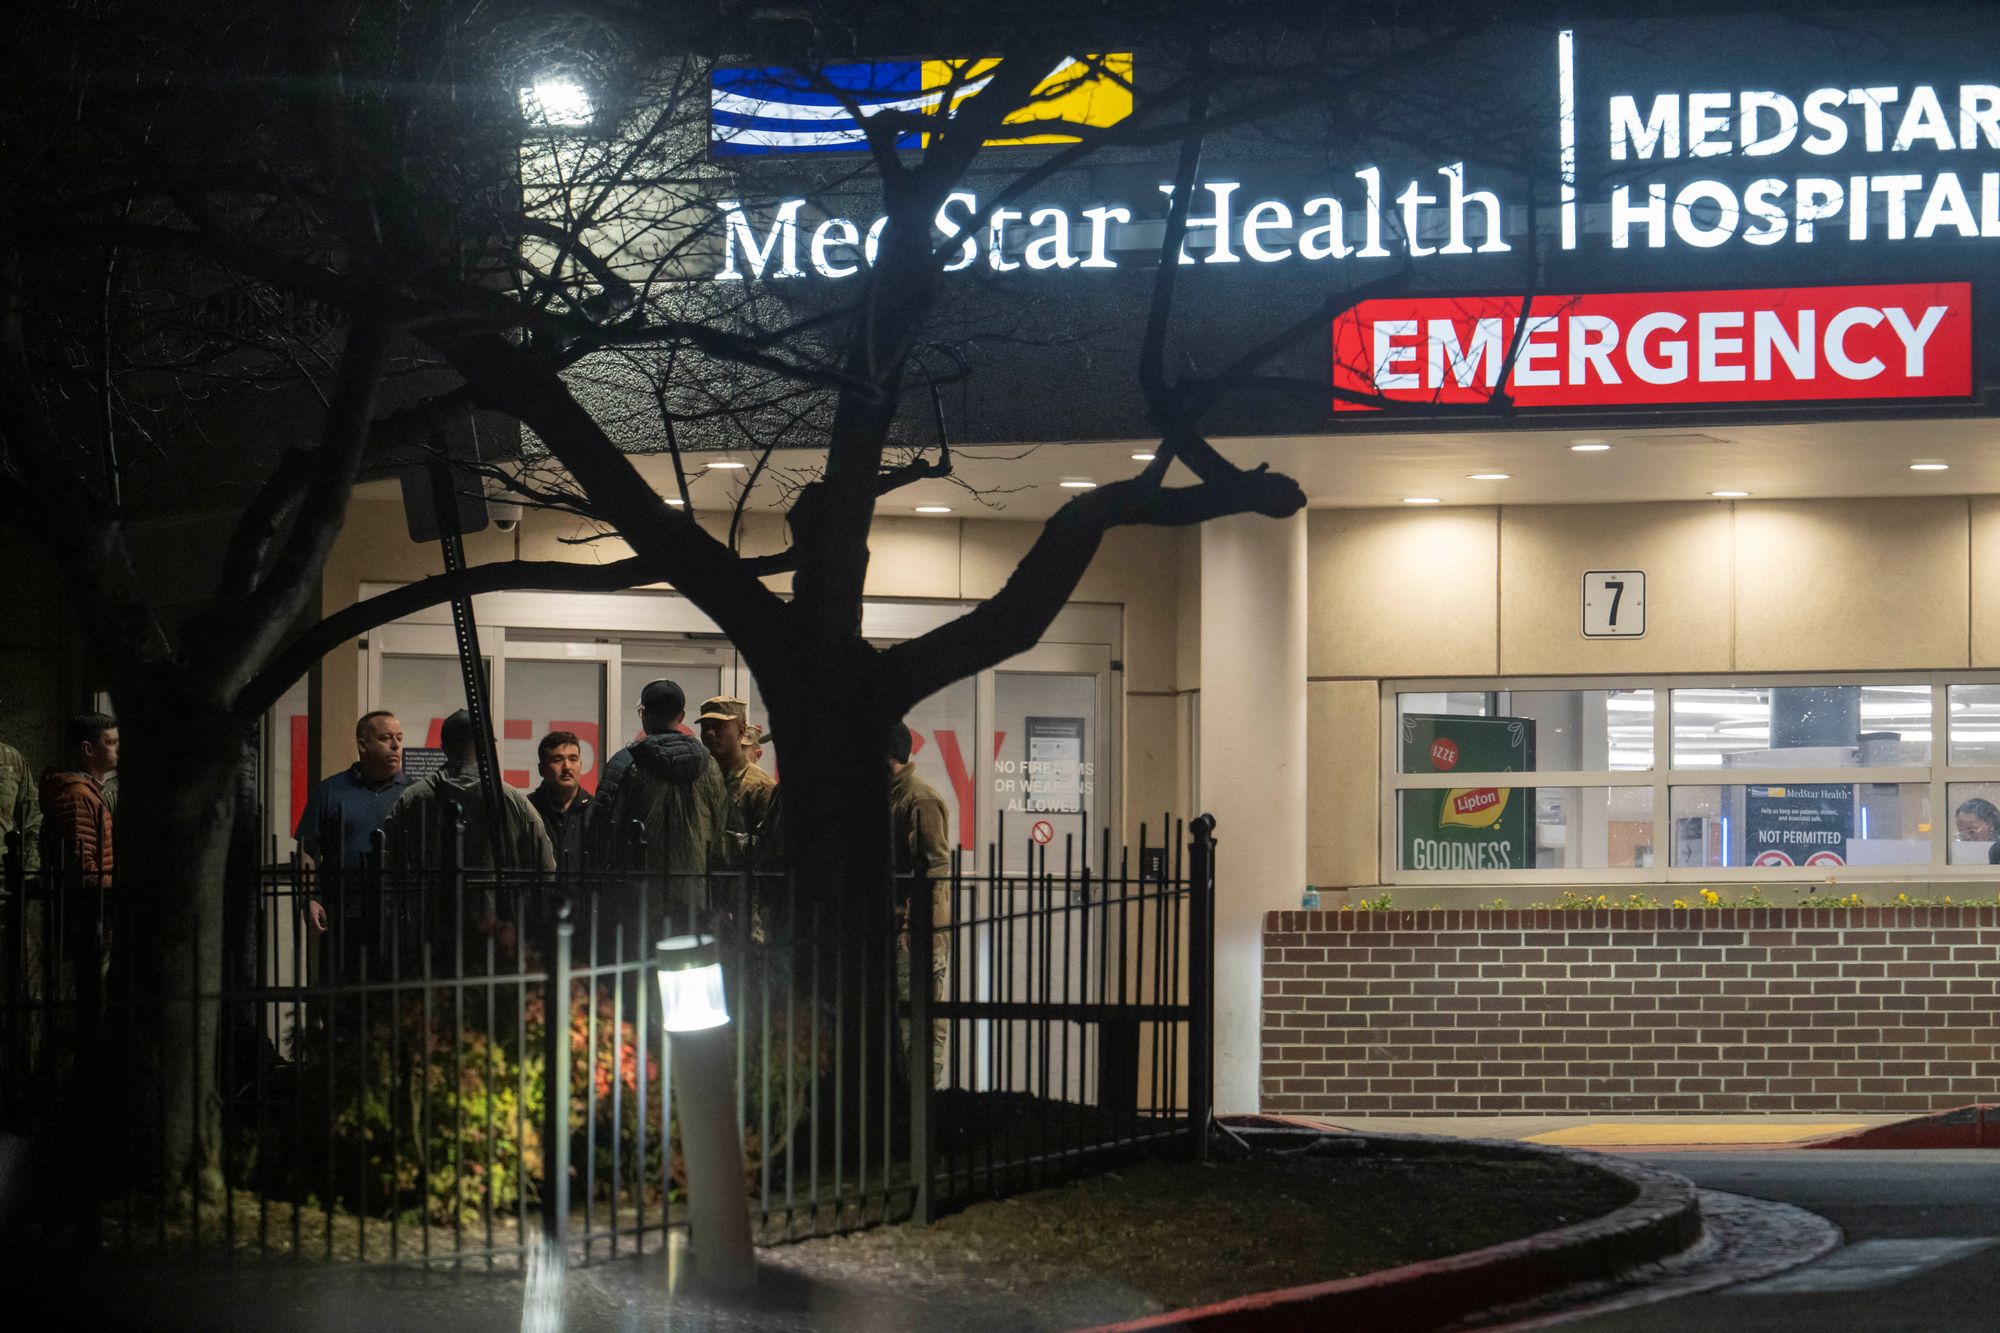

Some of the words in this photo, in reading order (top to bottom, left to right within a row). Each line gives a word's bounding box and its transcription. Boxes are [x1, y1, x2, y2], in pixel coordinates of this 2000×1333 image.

[1609, 84, 2000, 161] MEDSTAR
[1610, 172, 2000, 249] HOSPITAL
[714, 192, 1131, 280] MeStar
[1158, 162, 1511, 265] Health
[1373, 305, 1949, 390] EMERGENCY
[1604, 581, 1624, 626] 7
[1432, 745, 1456, 763] IZZE
[994, 760, 1016, 774] NO
[1019, 761, 1094, 776] FIREMS
[994, 779, 1016, 793] OR
[1019, 780, 1094, 794] WEANS
[1786, 788, 1819, 799] MedStar
[1821, 789, 1848, 800] Health
[1007, 798, 1080, 813] ALLOWED
[1457, 792, 1497, 811] Lipton
[1759, 830, 1781, 843] NOT
[1783, 831, 1841, 845] PERMITTED
[1413, 838, 1511, 870] GOODNESS
